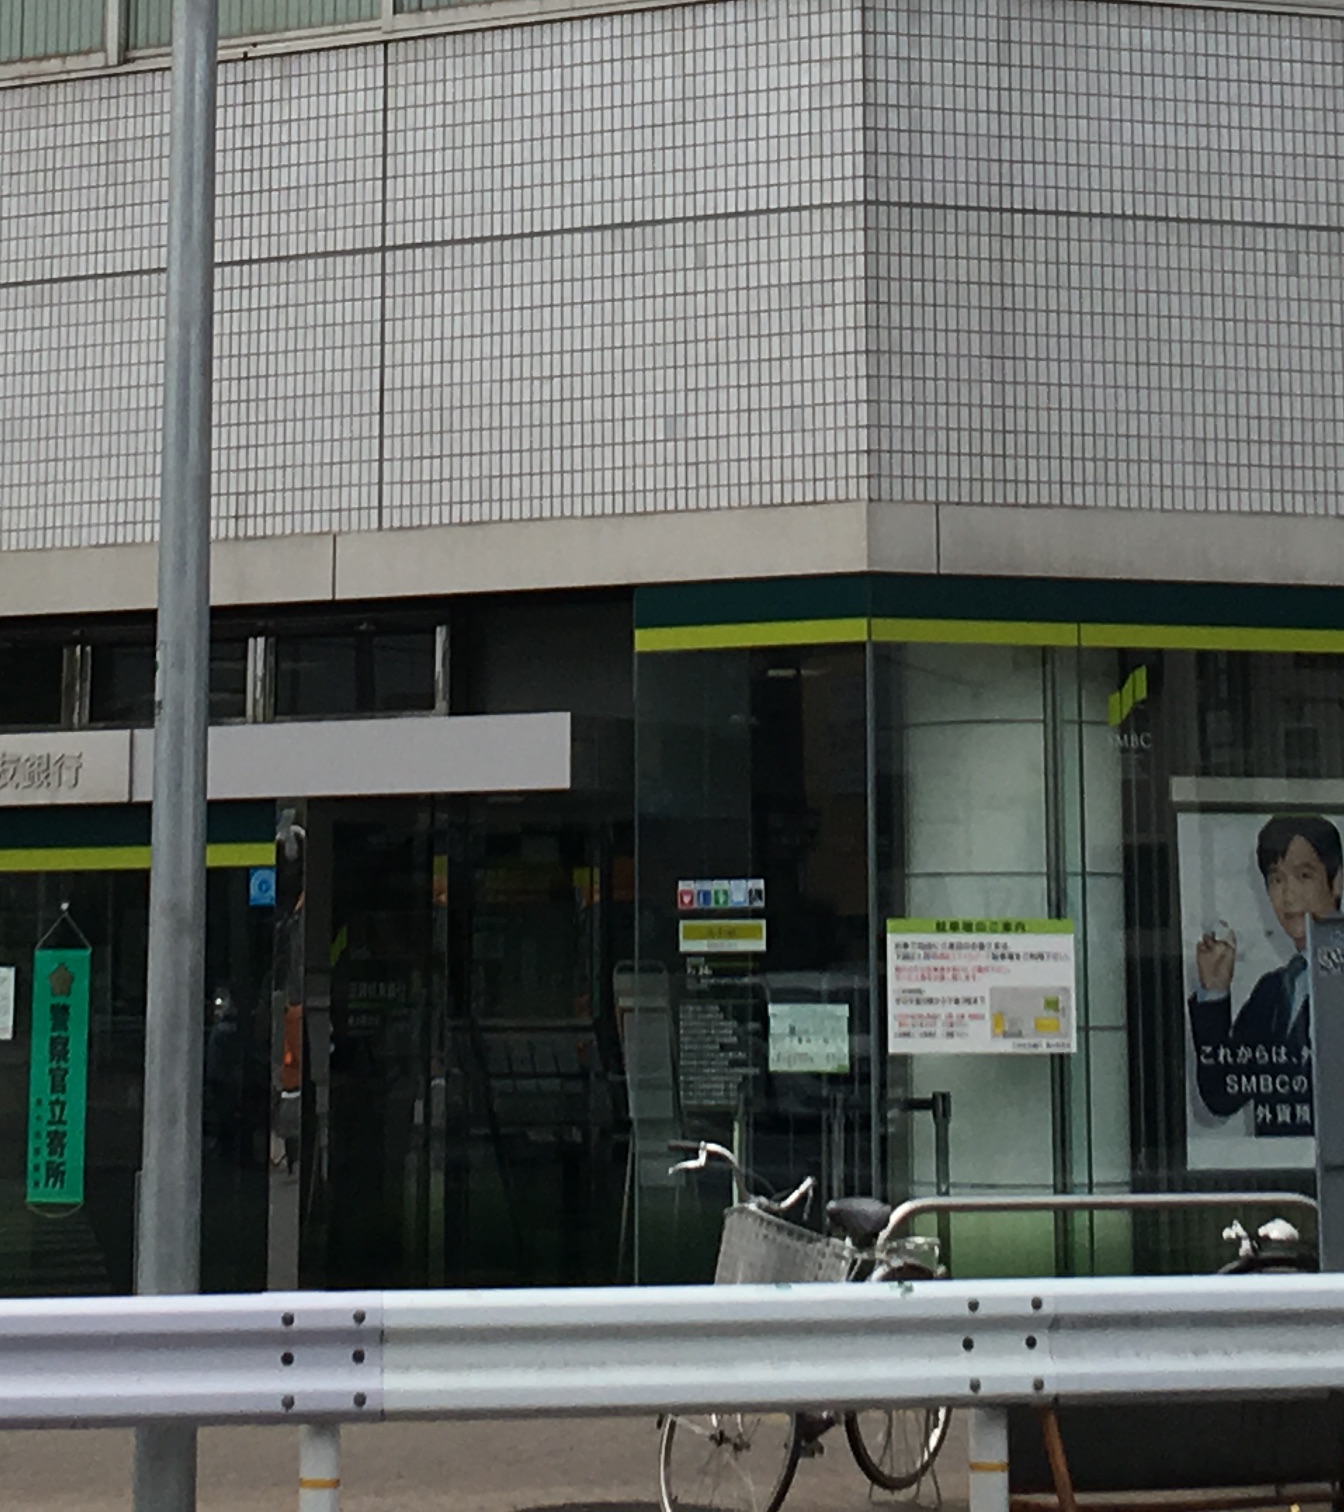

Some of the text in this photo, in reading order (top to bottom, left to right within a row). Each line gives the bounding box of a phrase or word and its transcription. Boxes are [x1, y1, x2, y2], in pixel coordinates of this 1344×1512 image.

[44, 1002, 71, 1190] 警察官立寄所
[1225, 1073, 1308, 1094] SMBCの
